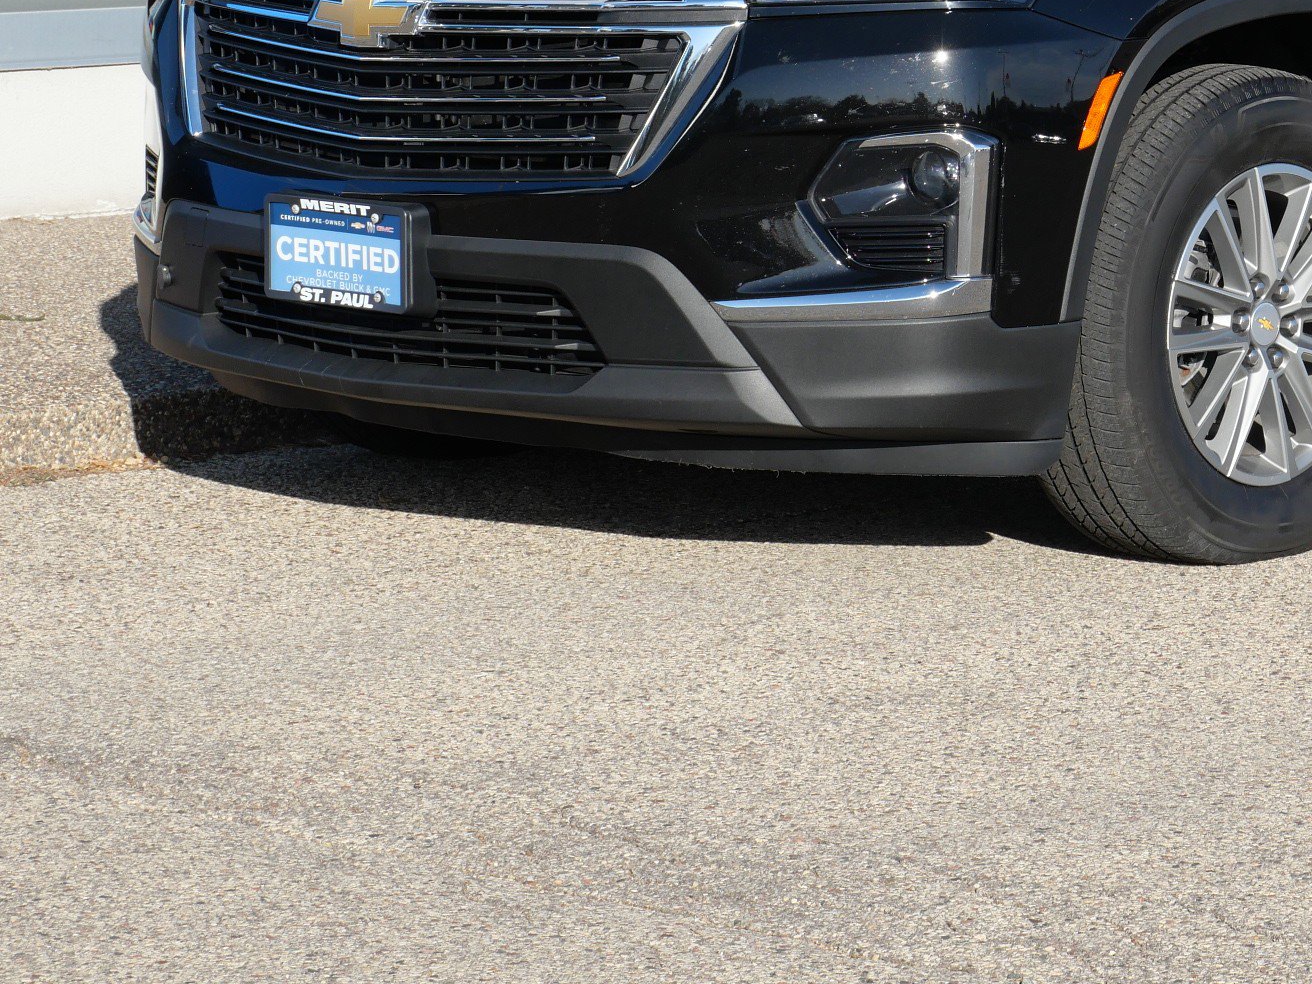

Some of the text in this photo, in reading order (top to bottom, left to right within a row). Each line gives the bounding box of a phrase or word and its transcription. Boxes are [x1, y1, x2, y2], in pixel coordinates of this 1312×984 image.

[300, 198, 371, 217] MERIT
[280, 213, 395, 233] CERTIFIED PRE-OWNED GMC
[275, 235, 400, 274] CERTIFIED
[286, 275, 336, 288] CHEVROLET
[339, 281, 364, 292] BUICK
[364, 286, 371, 294] &
[316, 269, 363, 282] BACKED BY
[299, 287, 374, 309] ST. PAUL
